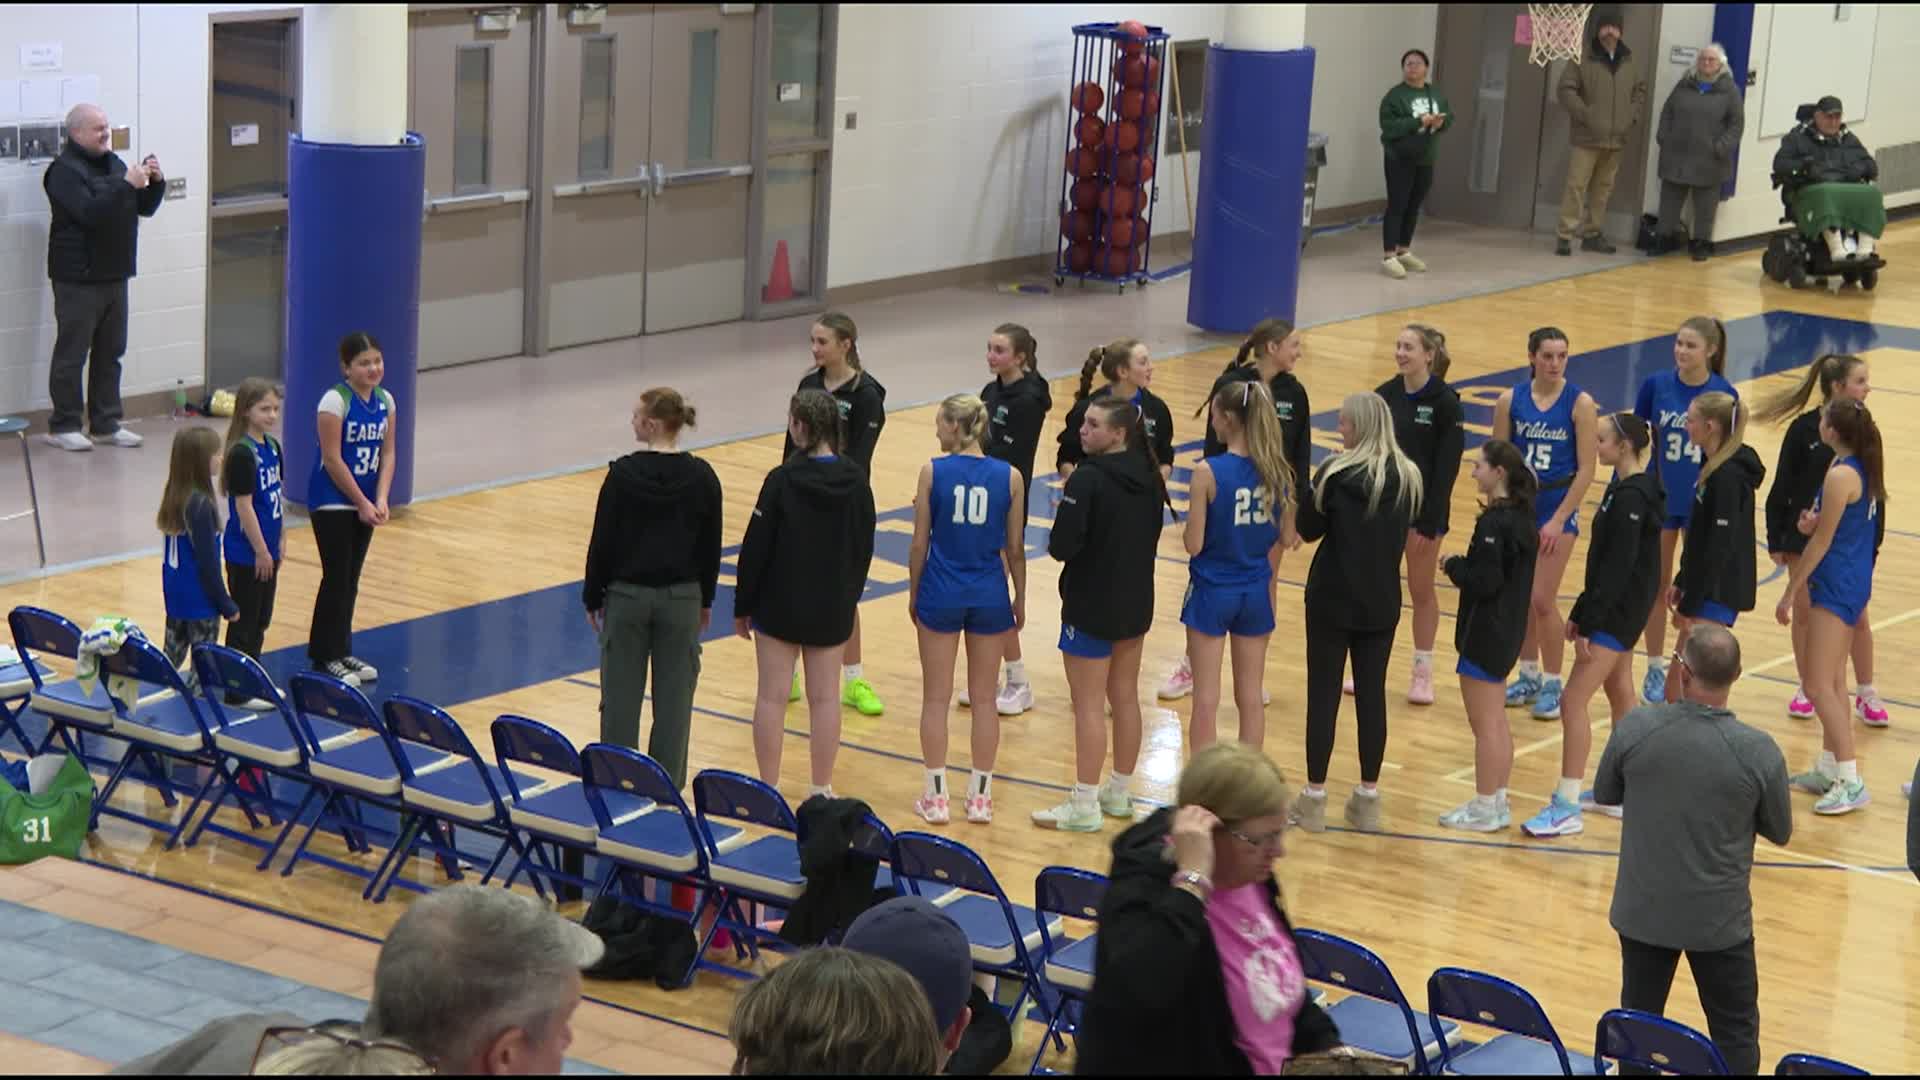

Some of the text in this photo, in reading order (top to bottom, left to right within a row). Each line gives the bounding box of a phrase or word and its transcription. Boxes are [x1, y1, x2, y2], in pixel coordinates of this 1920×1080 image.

[1515, 420, 1568, 440] Wildcats
[354, 447, 380, 475] 34
[1525, 443, 1552, 470] 15
[1665, 432, 1701, 463] 34
[952, 485, 988, 525] 10
[1234, 487, 1272, 527] 23
[23, 816, 52, 843] 31
